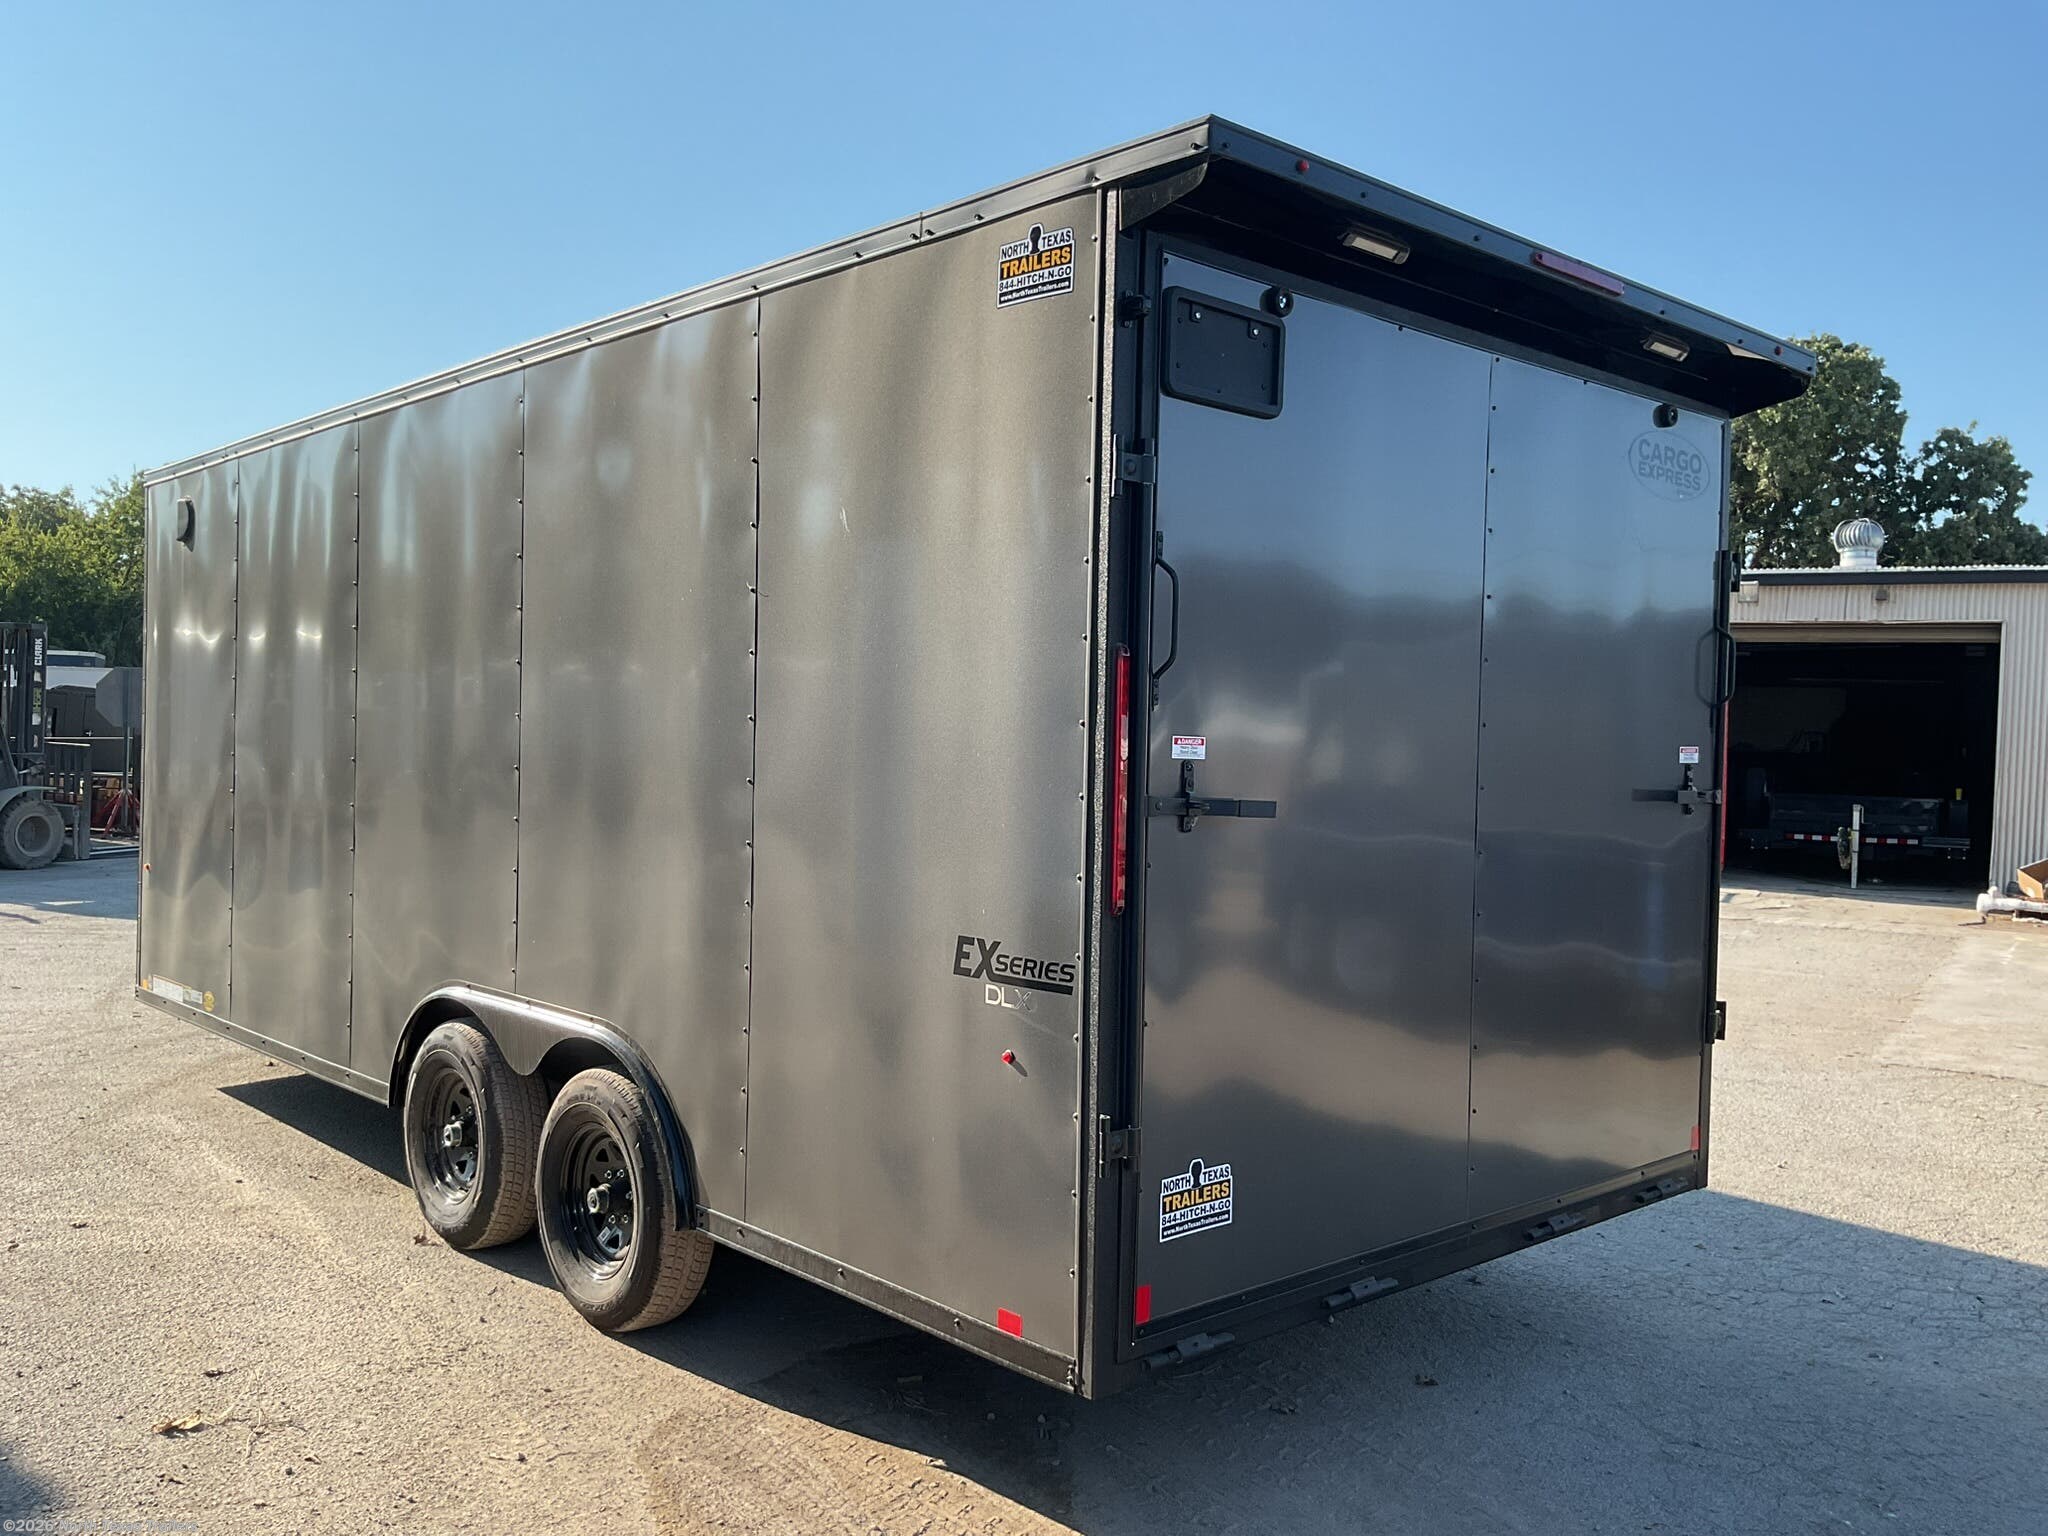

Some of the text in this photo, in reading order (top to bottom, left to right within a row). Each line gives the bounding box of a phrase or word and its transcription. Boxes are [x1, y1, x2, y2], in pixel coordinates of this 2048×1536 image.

[1001, 230, 1071, 259] NORTH TEXAS
[1001, 246, 1071, 278] TRAILERS
[1638, 438, 1702, 474] CARGO
[1638, 460, 1702, 492] EXPRESS
[34, 638, 43, 666] CLARK
[984, 983, 1032, 1012] DLX
[1163, 1166, 1230, 1194] NORTH TEXAS
[1163, 1181, 1230, 1213] TRAILERS
